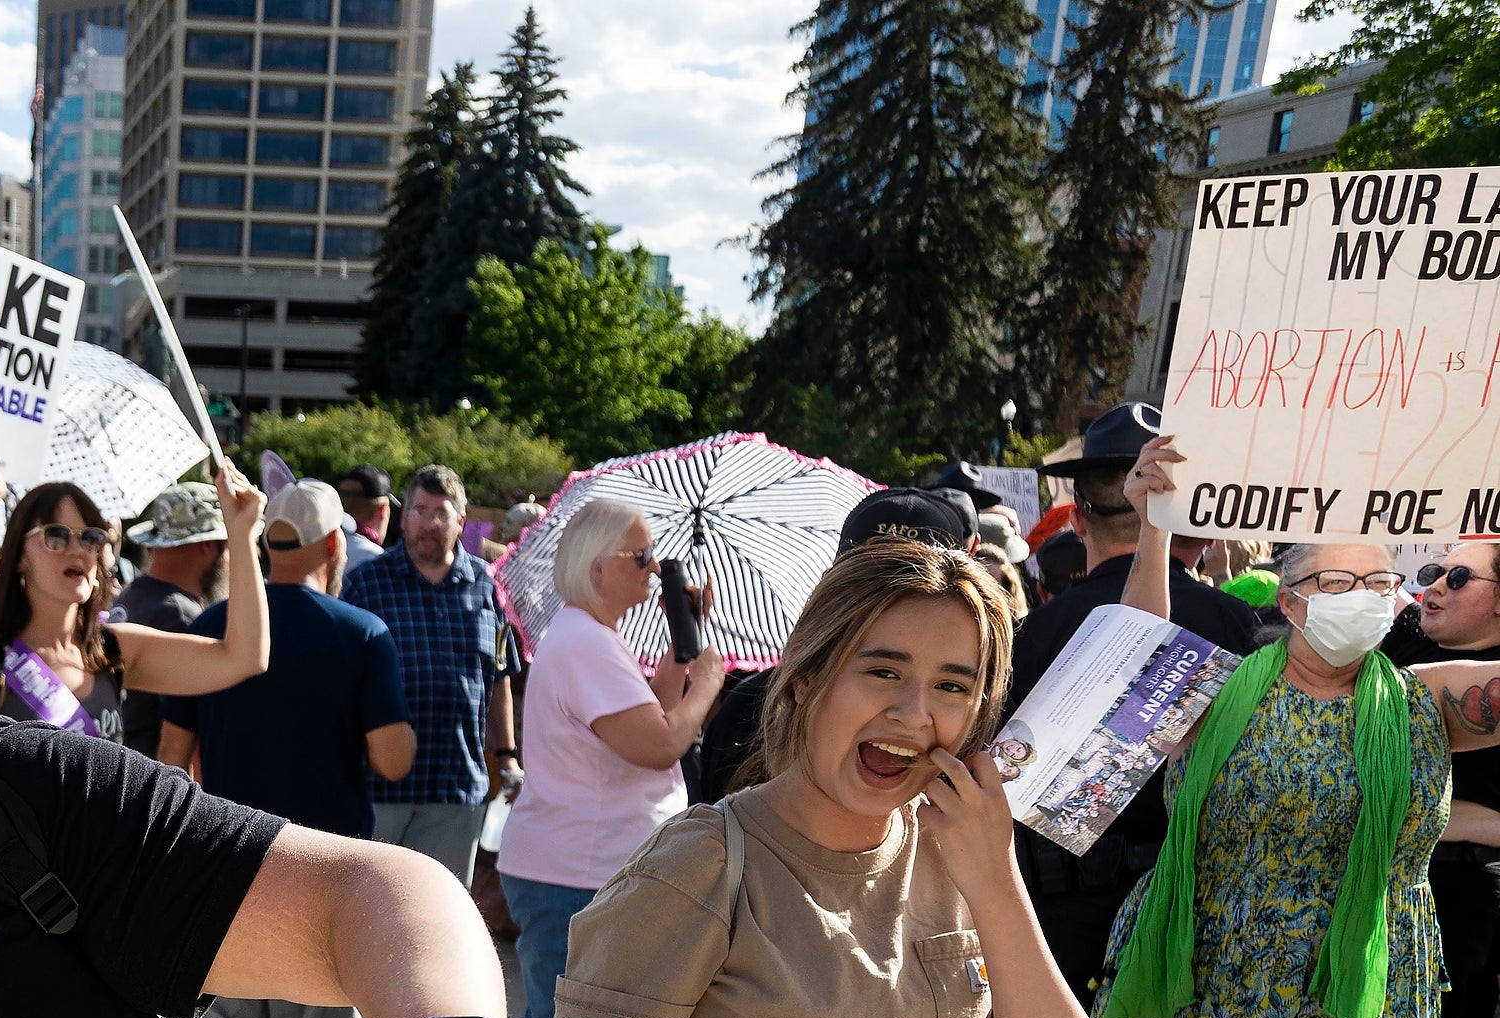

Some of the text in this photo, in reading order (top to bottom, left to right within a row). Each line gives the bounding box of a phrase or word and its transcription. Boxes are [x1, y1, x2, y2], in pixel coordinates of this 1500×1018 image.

[1199, 177, 1309, 230] KEEP
[1329, 174, 1442, 228] YOUR
[1327, 229, 1500, 282] MY BOD
[1173, 325, 1427, 411] ABORTION
[1188, 482, 1342, 535] CODIFY
[1137, 649, 1199, 723] CURRENT
[1145, 643, 1187, 690] HIGHLIGHTS
